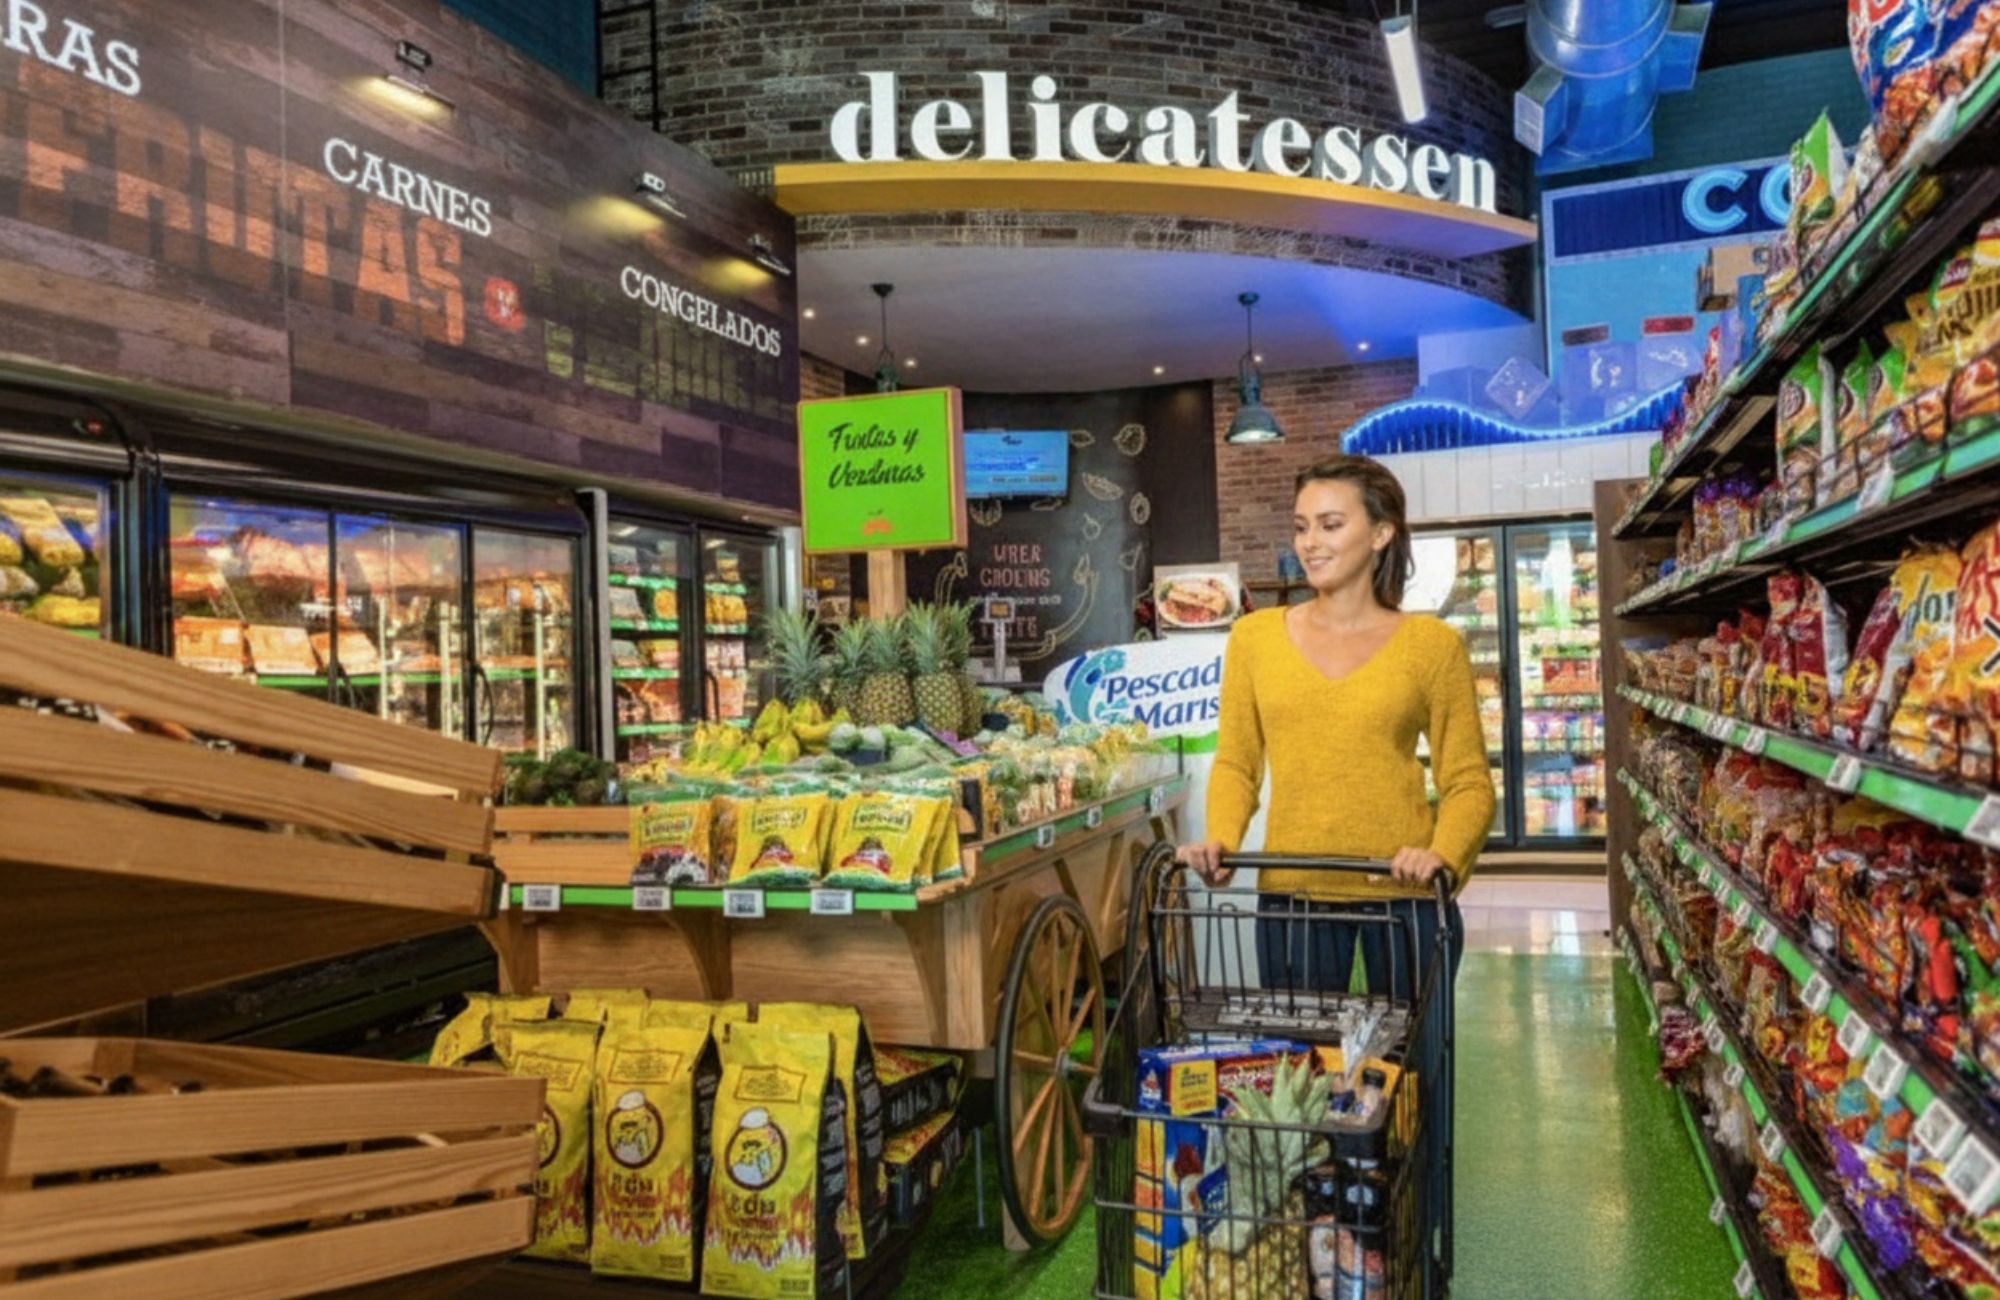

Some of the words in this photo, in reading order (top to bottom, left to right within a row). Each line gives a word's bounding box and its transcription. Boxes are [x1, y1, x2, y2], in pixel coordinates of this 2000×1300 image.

[323, 136, 492, 238] CARNES
[829, 70, 1497, 214] delicatessen
[620, 265, 782, 357] CONGELADOS
[1101, 655, 1222, 704] Pescad
